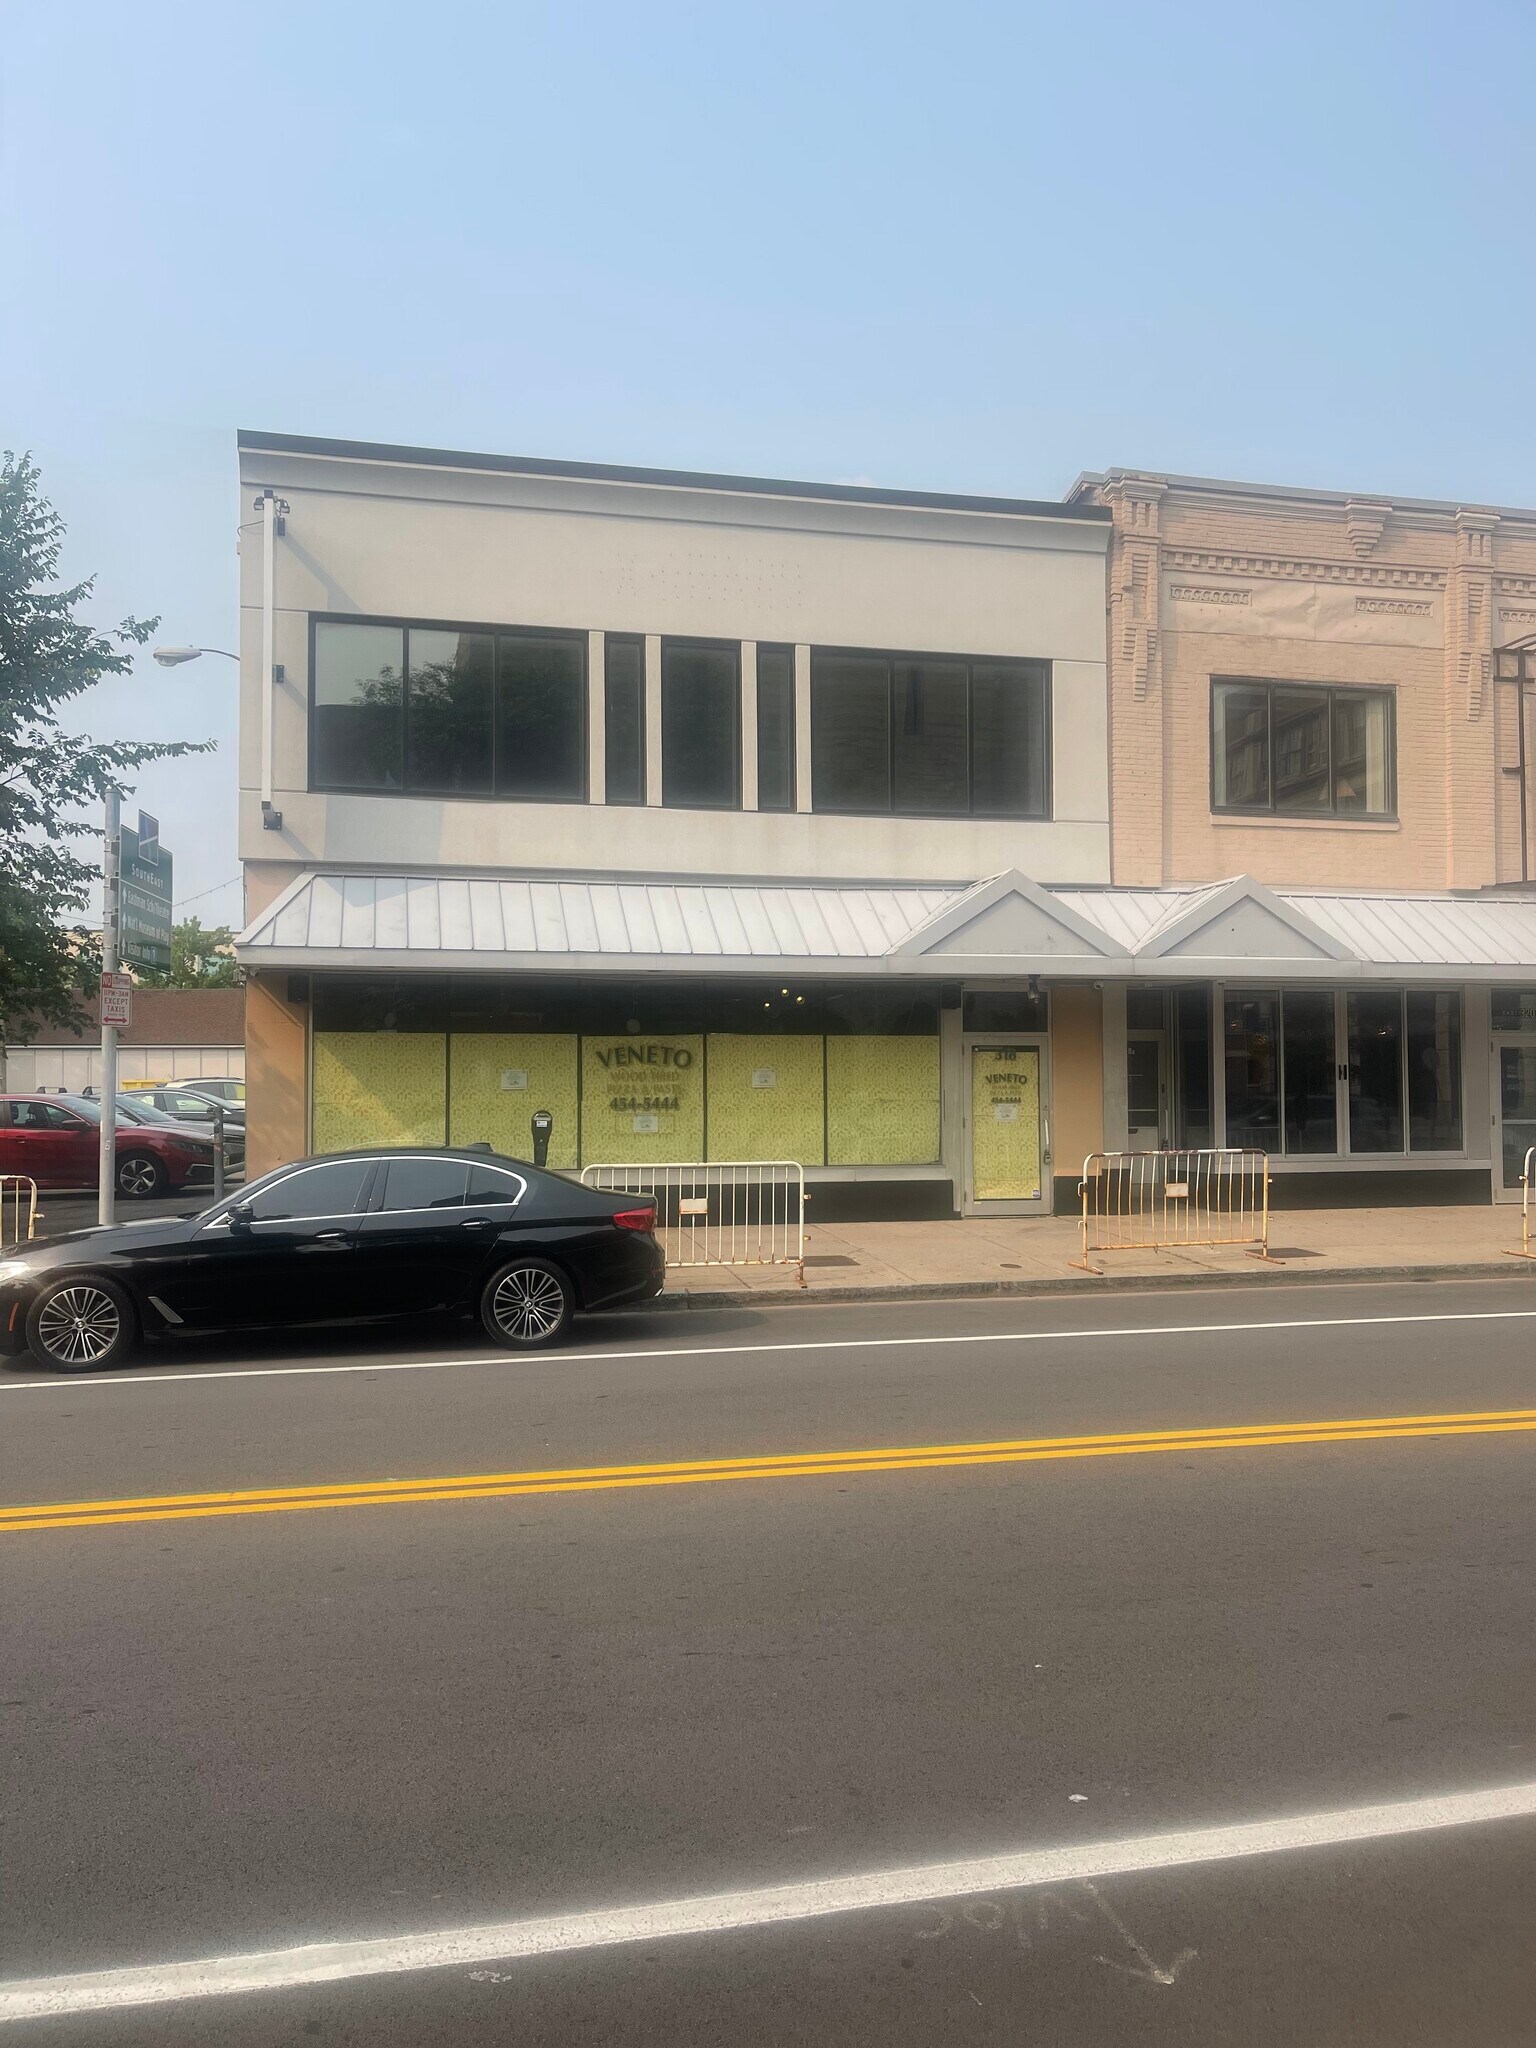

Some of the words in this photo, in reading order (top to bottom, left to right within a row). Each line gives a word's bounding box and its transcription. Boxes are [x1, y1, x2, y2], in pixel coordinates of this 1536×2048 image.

[139, 920, 156, 938] Museum
[103, 975, 112, 986] NO
[104, 997, 129, 1005] EXCEPT
[107, 1005, 125, 1013] TAXIS
[596, 1045, 692, 1070] VENETO
[985, 1073, 1028, 1085] VENETO
[610, 1096, 680, 1111] 454-5444
